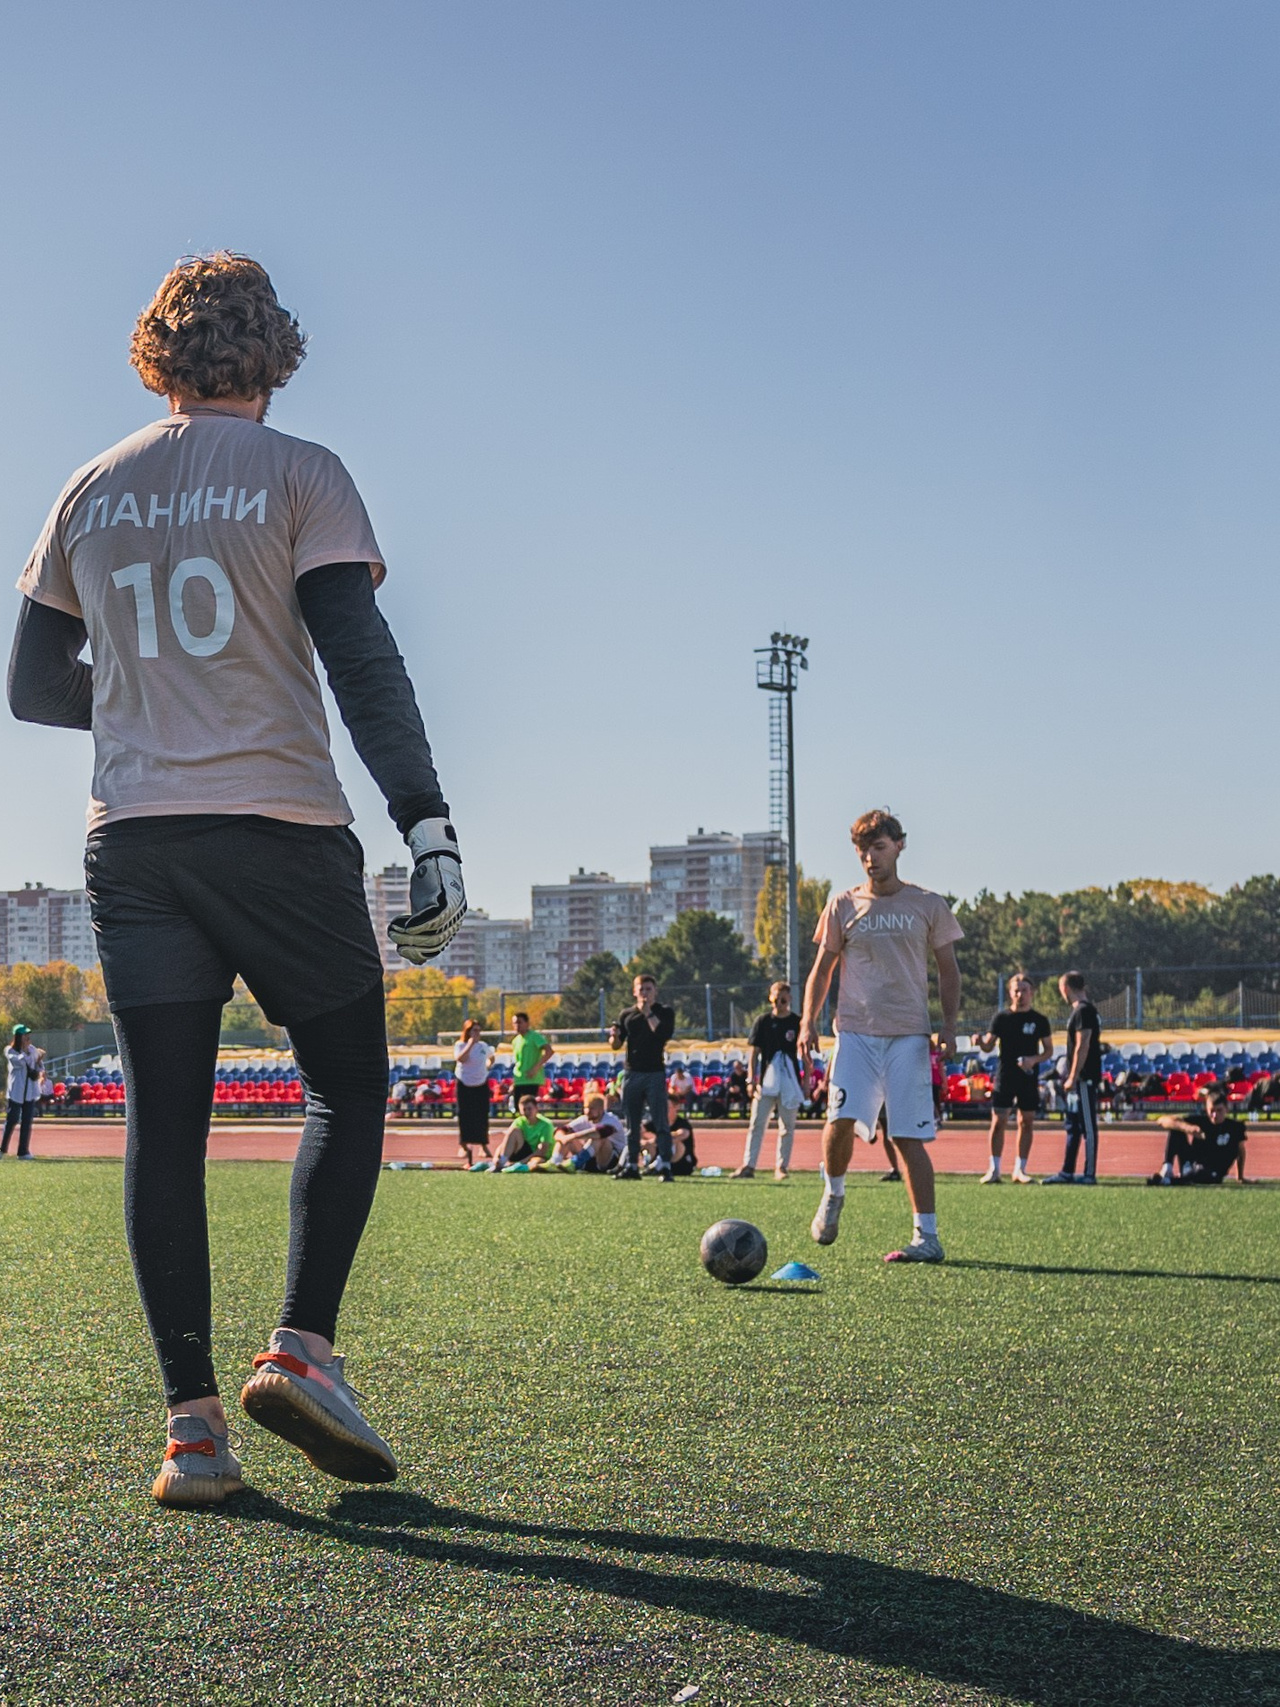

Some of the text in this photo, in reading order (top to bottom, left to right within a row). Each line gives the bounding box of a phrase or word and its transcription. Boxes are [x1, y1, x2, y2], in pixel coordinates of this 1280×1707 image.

[84, 485, 268, 534] ПАНИНИ
[110, 556, 236, 658] 10
[858, 913, 915, 933] SUNNY
